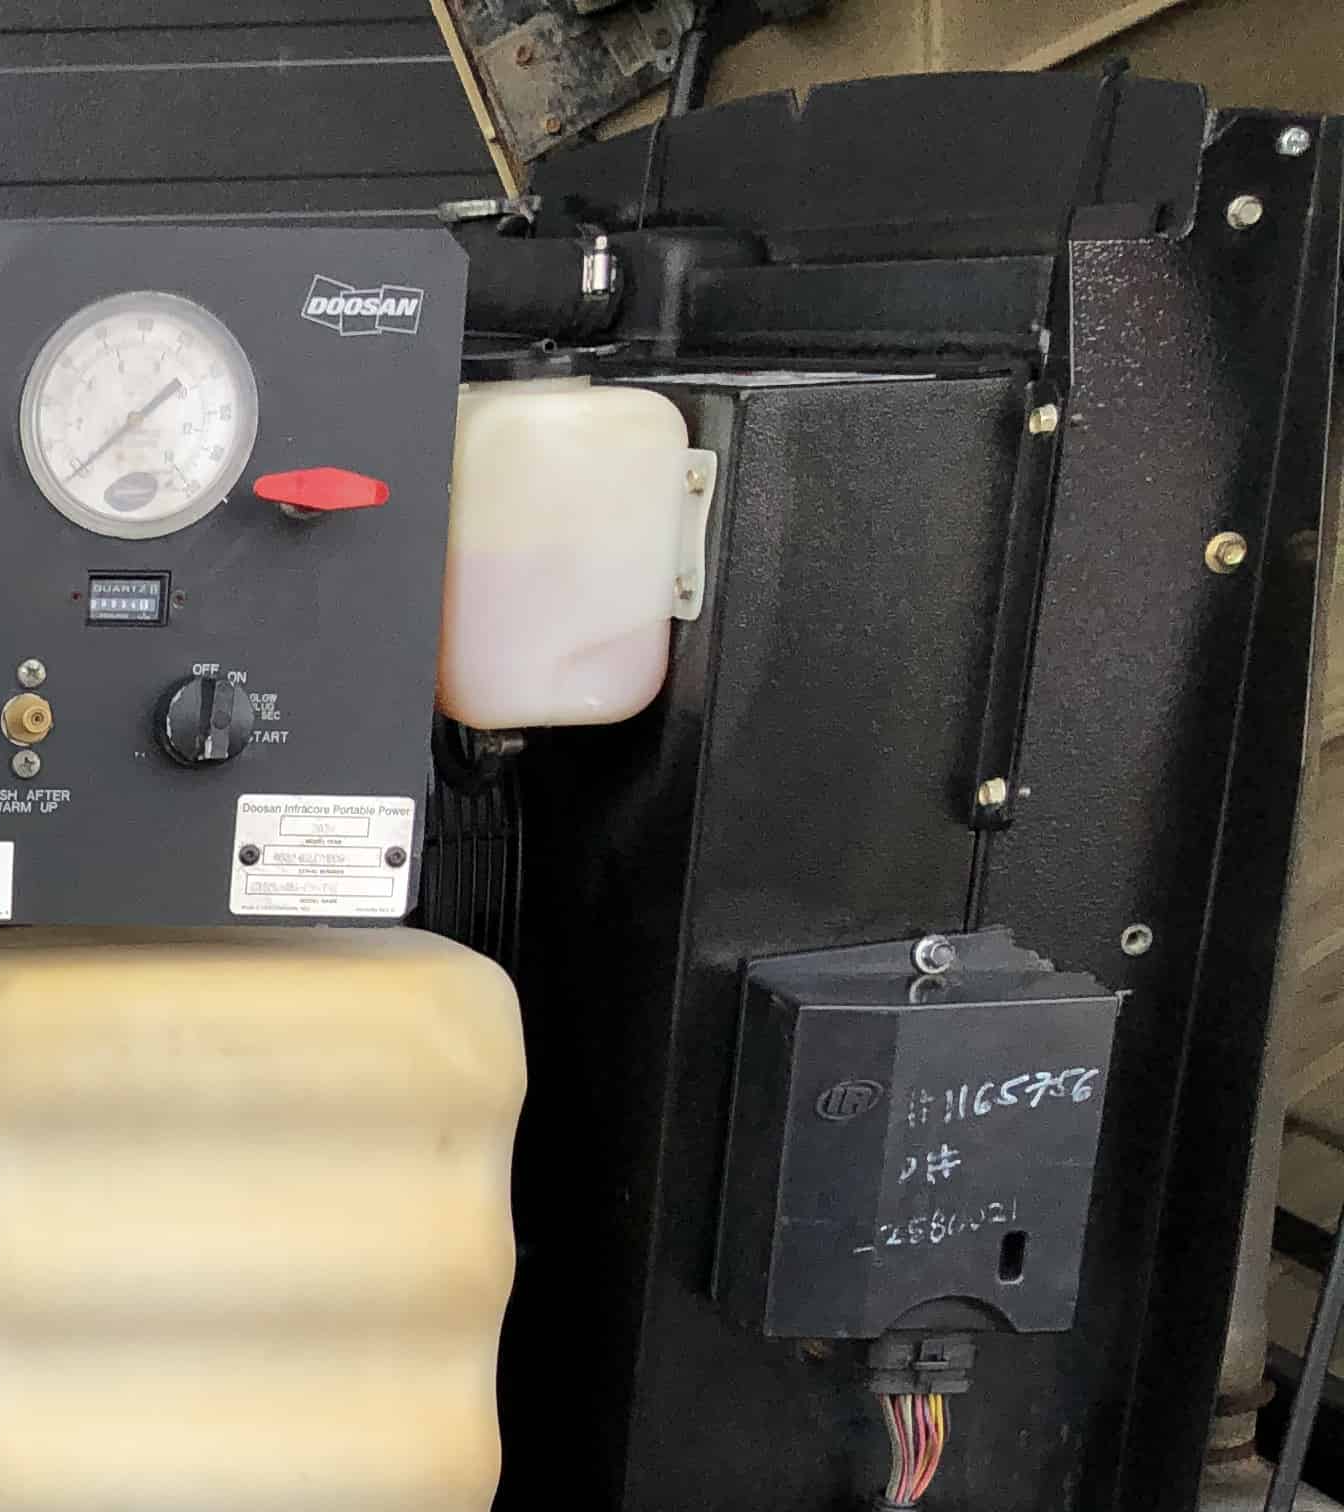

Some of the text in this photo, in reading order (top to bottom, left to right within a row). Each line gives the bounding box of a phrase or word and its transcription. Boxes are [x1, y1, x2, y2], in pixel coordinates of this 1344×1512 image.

[308, 297, 418, 315] DOOSAN
[193, 664, 219, 675] OFF
[228, 672, 247, 684] ON
[249, 731, 288, 743] TART
[27, 790, 70, 801] AFTER
[41, 802, 57, 812] UP
[243, 803, 411, 816] Doosan Infracore Portable Power
